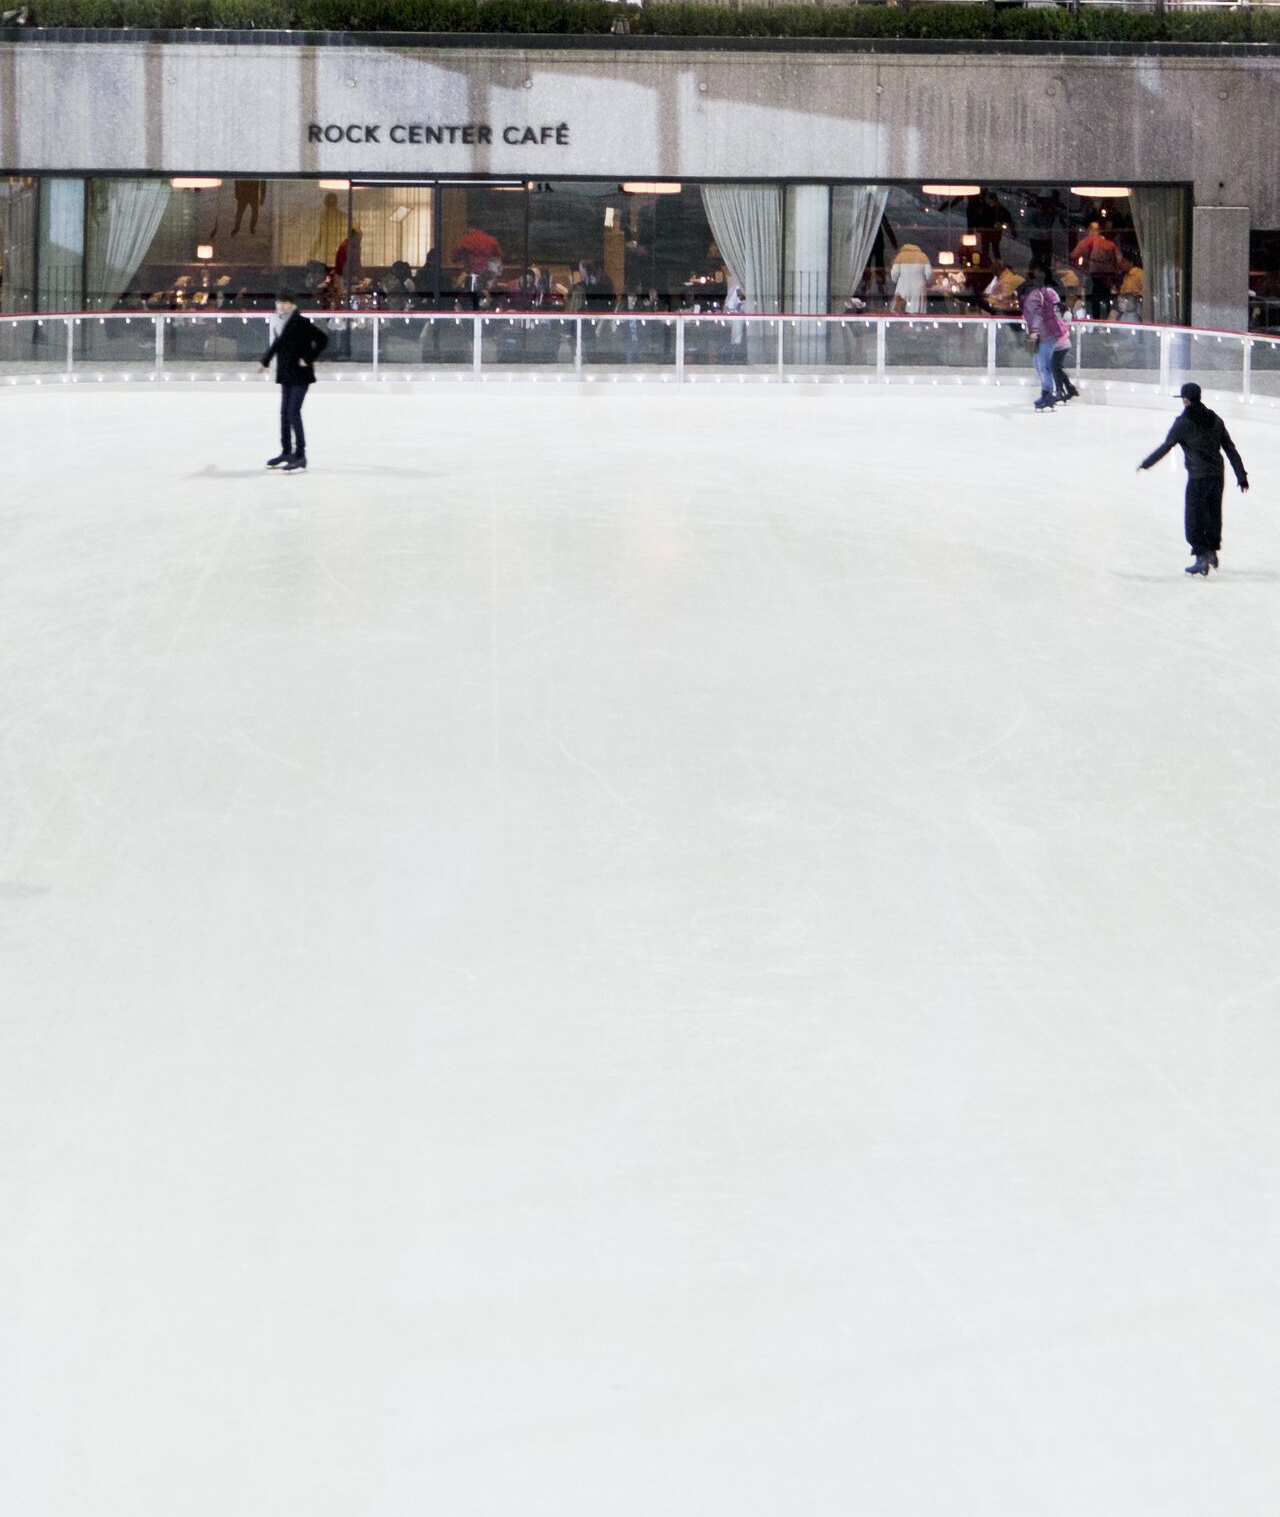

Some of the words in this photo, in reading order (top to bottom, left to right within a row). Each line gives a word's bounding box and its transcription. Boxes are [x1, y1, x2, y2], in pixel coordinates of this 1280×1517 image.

[308, 124, 381, 144] ROCK
[389, 124, 493, 145] CENTER
[502, 123, 570, 145] CAFÉ
